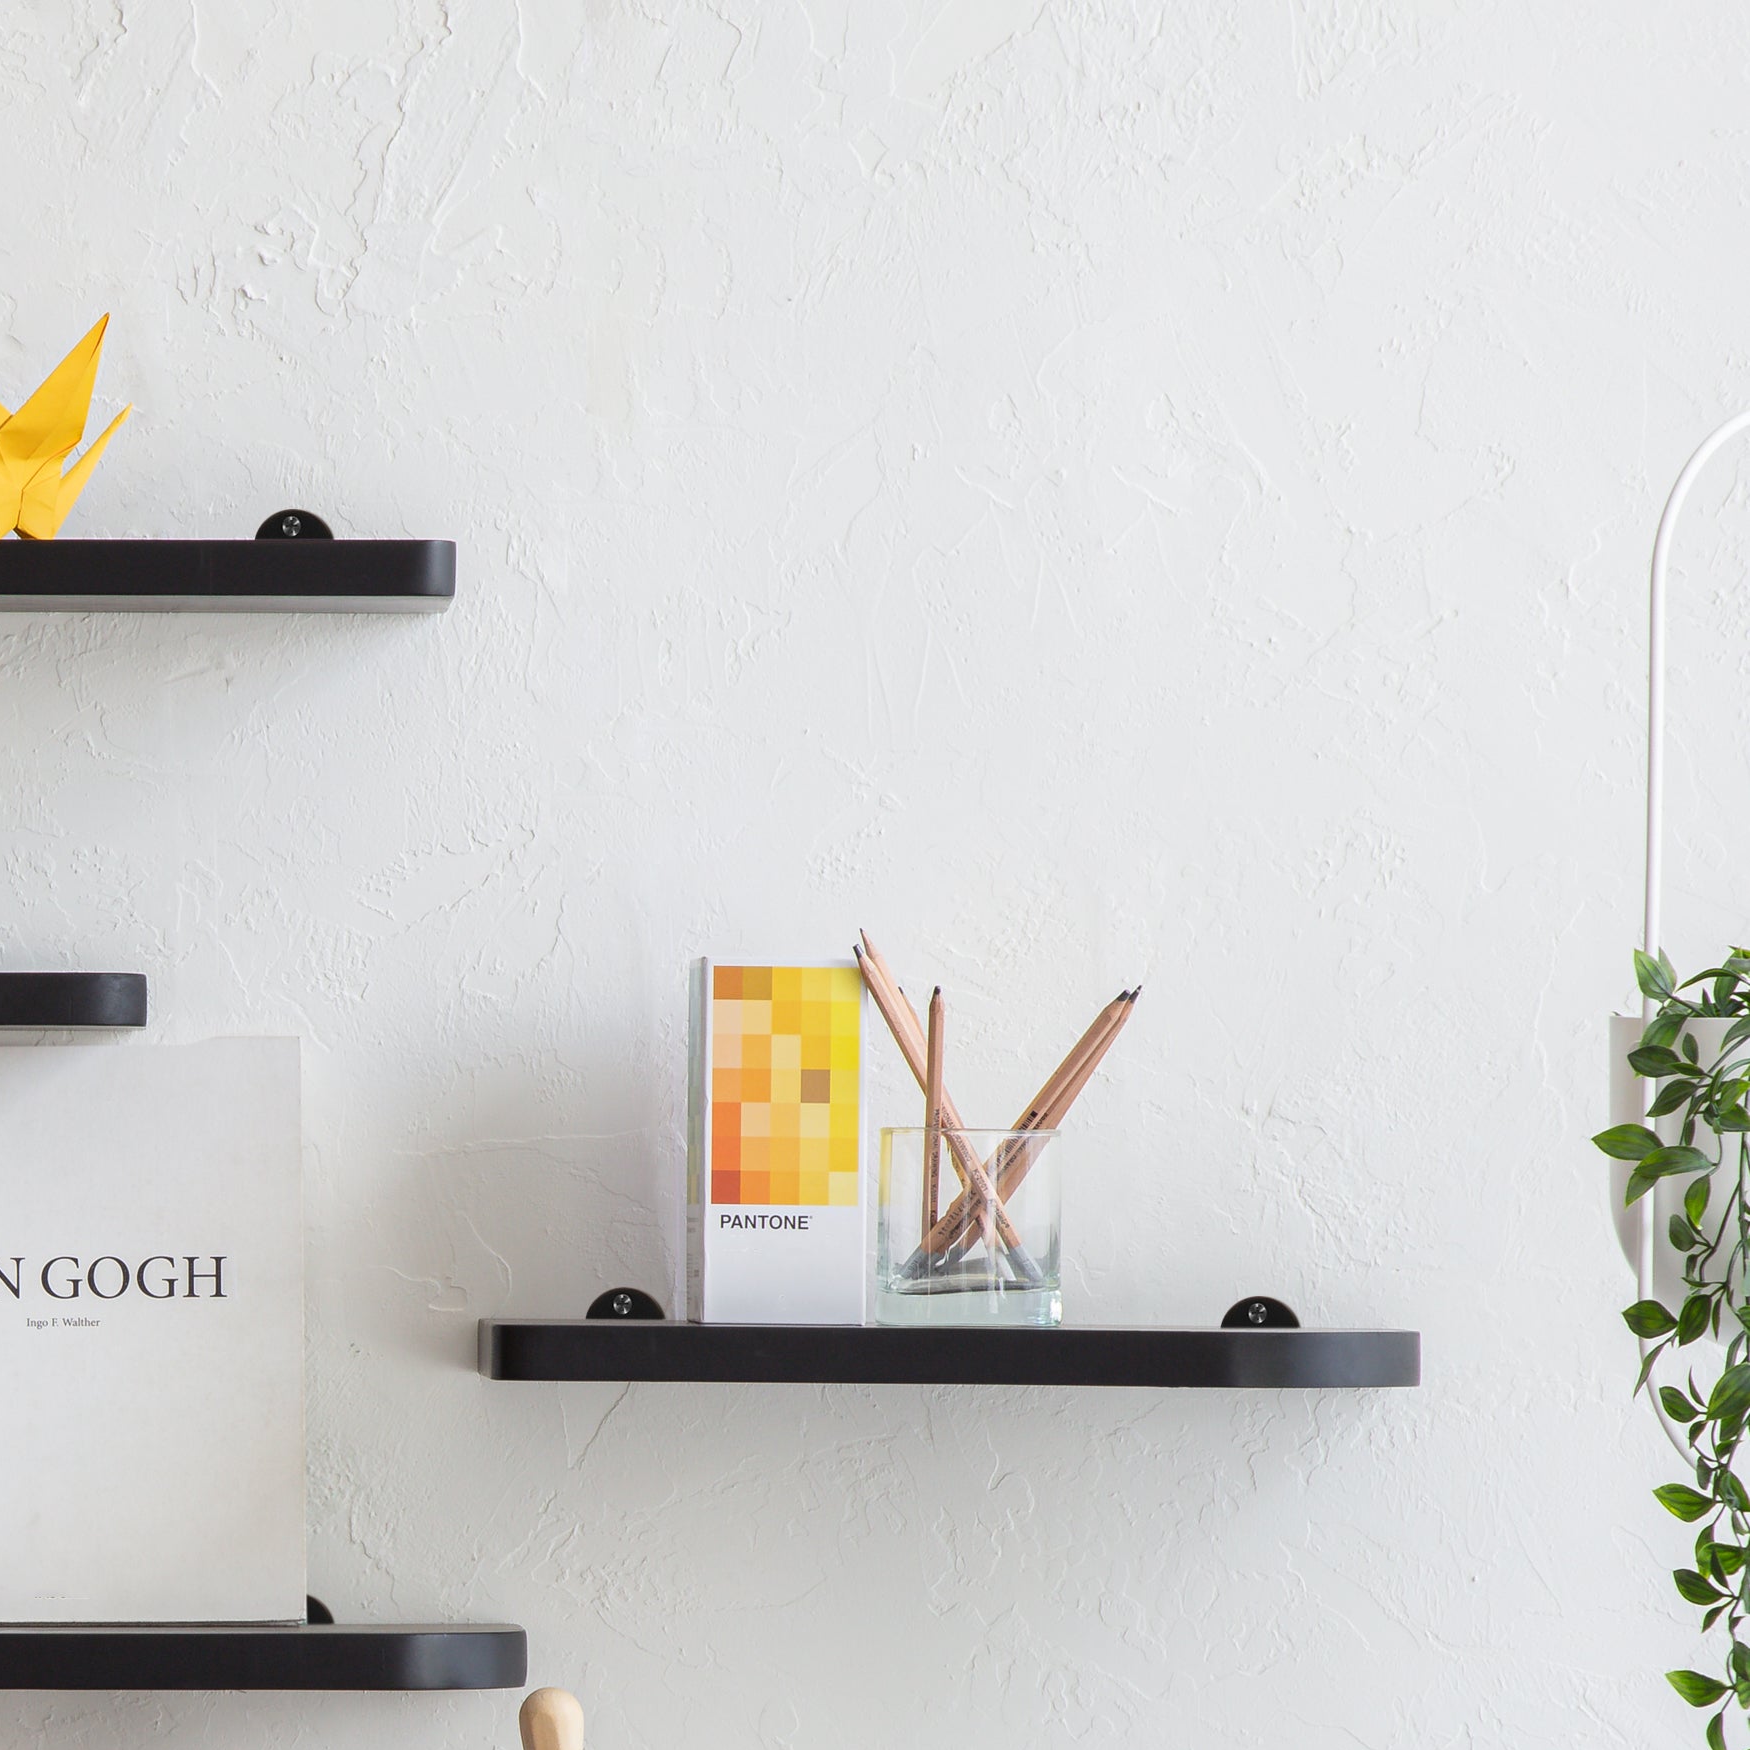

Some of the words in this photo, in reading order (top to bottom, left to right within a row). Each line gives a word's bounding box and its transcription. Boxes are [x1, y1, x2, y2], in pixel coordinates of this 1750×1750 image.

[40, 1256, 228, 1299] GOGH
[26, 1318, 49, 1330] Ingo
[51, 1318, 59, 1327] F.
[62, 1317, 101, 1327] Walther
